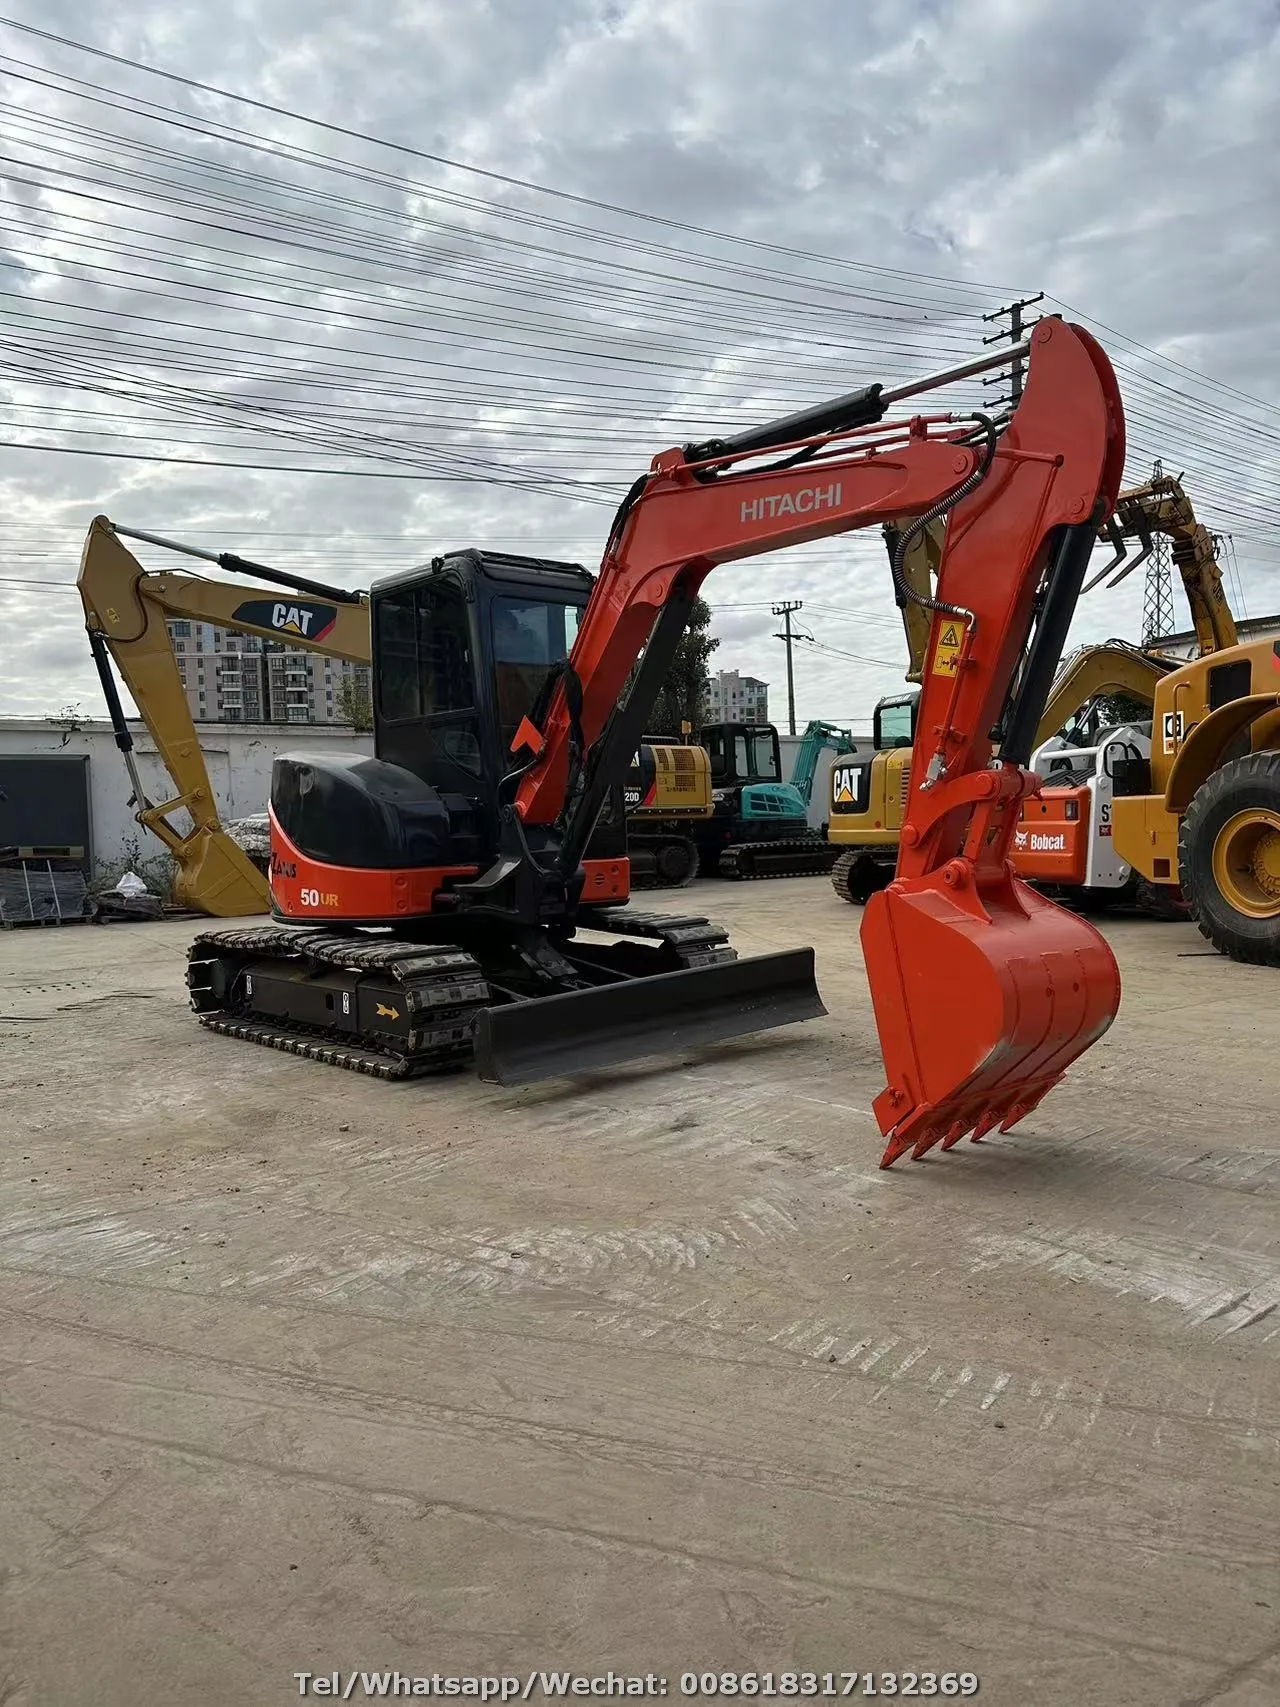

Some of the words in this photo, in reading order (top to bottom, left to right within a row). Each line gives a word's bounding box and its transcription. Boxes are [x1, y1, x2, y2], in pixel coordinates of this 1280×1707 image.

[741, 482, 842, 522] HITACHI
[272, 603, 313, 635] CAT
[833, 768, 862, 803] CAT
[1031, 833, 1065, 850] Bobcat
